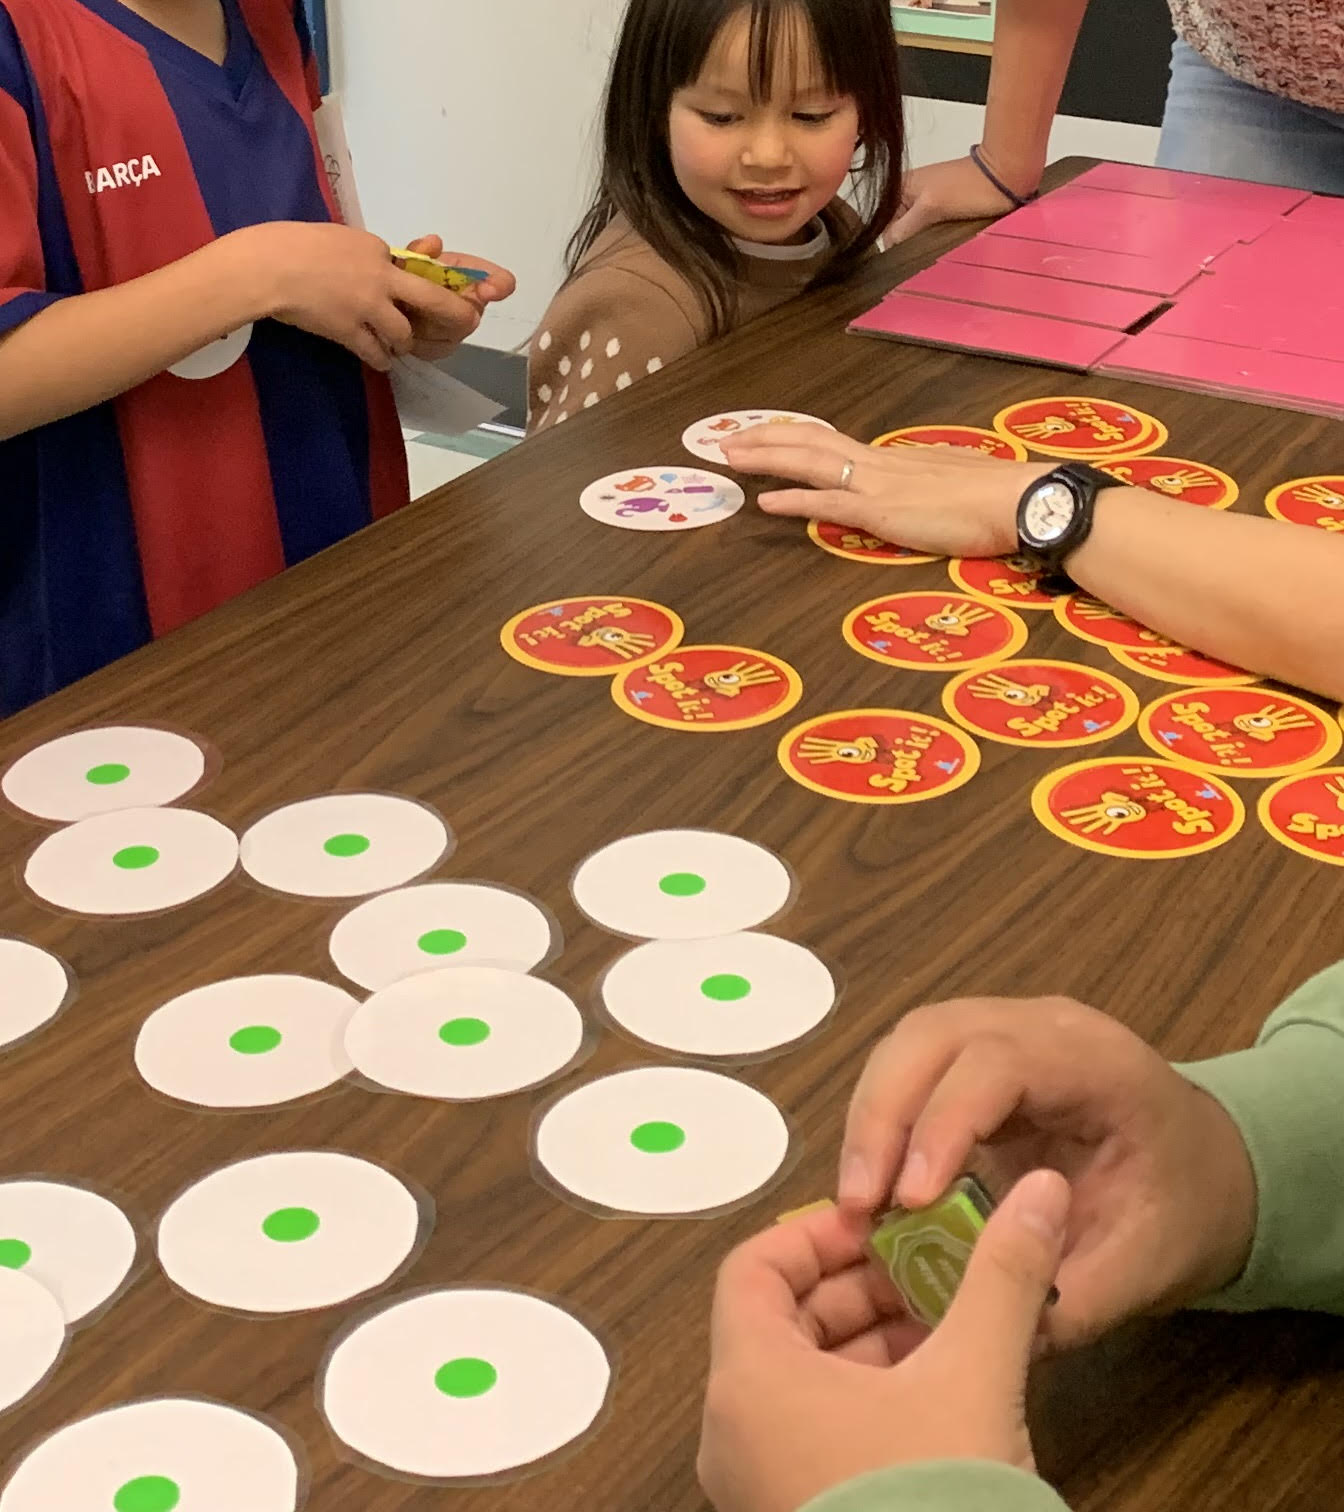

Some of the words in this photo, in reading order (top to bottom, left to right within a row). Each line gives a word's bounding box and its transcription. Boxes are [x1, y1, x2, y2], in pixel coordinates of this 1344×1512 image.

[558, 601, 633, 631] Spot
[864, 611, 931, 643] Spot
[646, 661, 699, 699] Spot
[1006, 700, 1080, 738] Spot
[1171, 701, 1233, 741] Spot
[868, 747, 922, 793] Spot
[1146, 789, 1216, 836] Spot
